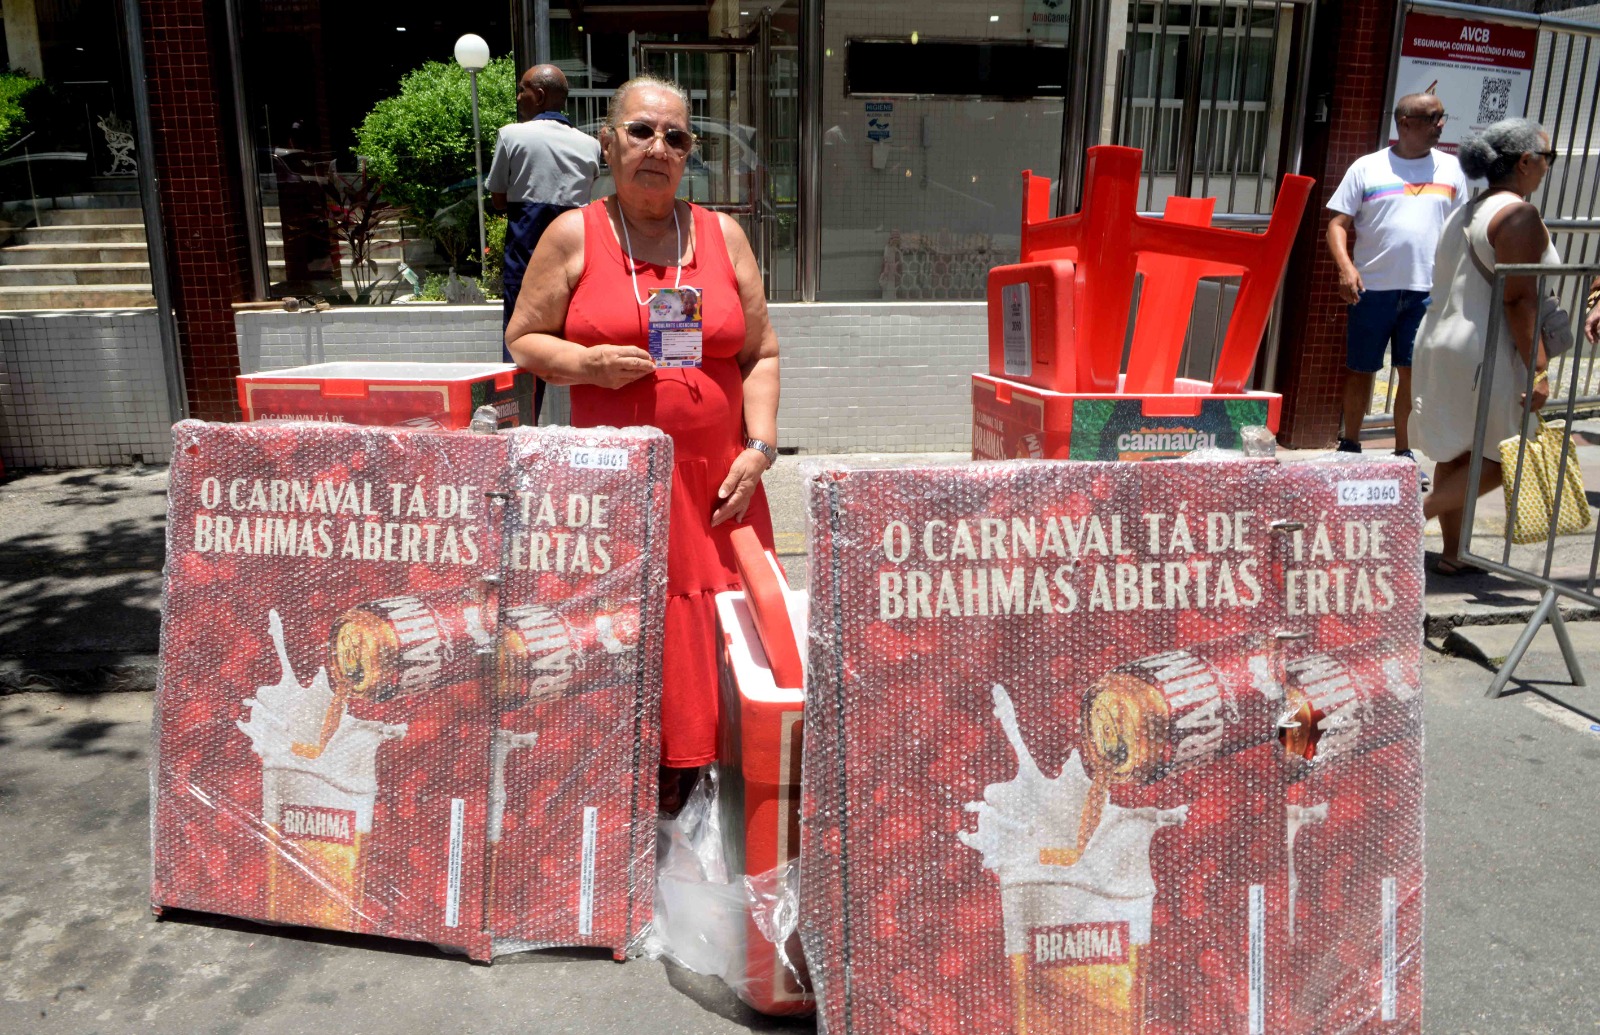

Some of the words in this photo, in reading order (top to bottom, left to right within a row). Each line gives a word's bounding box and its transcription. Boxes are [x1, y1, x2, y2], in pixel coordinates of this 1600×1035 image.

[1414, 38, 1450, 50] SEGURANÇA
[1452, 42, 1474, 52] CONTRA
[1476, 44, 1501, 56] INCÊNDIO
[1502, 48, 1506, 56] E
[1506, 48, 1525, 58] PÂNICO
[1460, 26, 1490, 42] AVCB
[974, 424, 1004, 460] BRAHMAS
[201, 477, 221, 508] O
[229, 478, 377, 515] CARNAVAL
[389, 476, 427, 518] TÁ
[438, 484, 477, 521] DE
[520, 487, 556, 528] TÁ
[568, 494, 609, 529] DE
[194, 514, 333, 558] BRAHMAS
[342, 522, 479, 566] ABERTAS
[884, 521, 911, 564] O
[924, 516, 1135, 562] CARNAVAL
[1144, 502, 1196, 555] TÁ
[1208, 510, 1255, 553] DE
[1292, 511, 1334, 562] TÁ
[1344, 520, 1390, 560] DE
[879, 563, 1079, 621] BRAHMAS
[1088, 558, 1262, 613] ABERTAS
[284, 810, 350, 840] BRAHMA
[1035, 928, 1123, 962] BRAHMA
